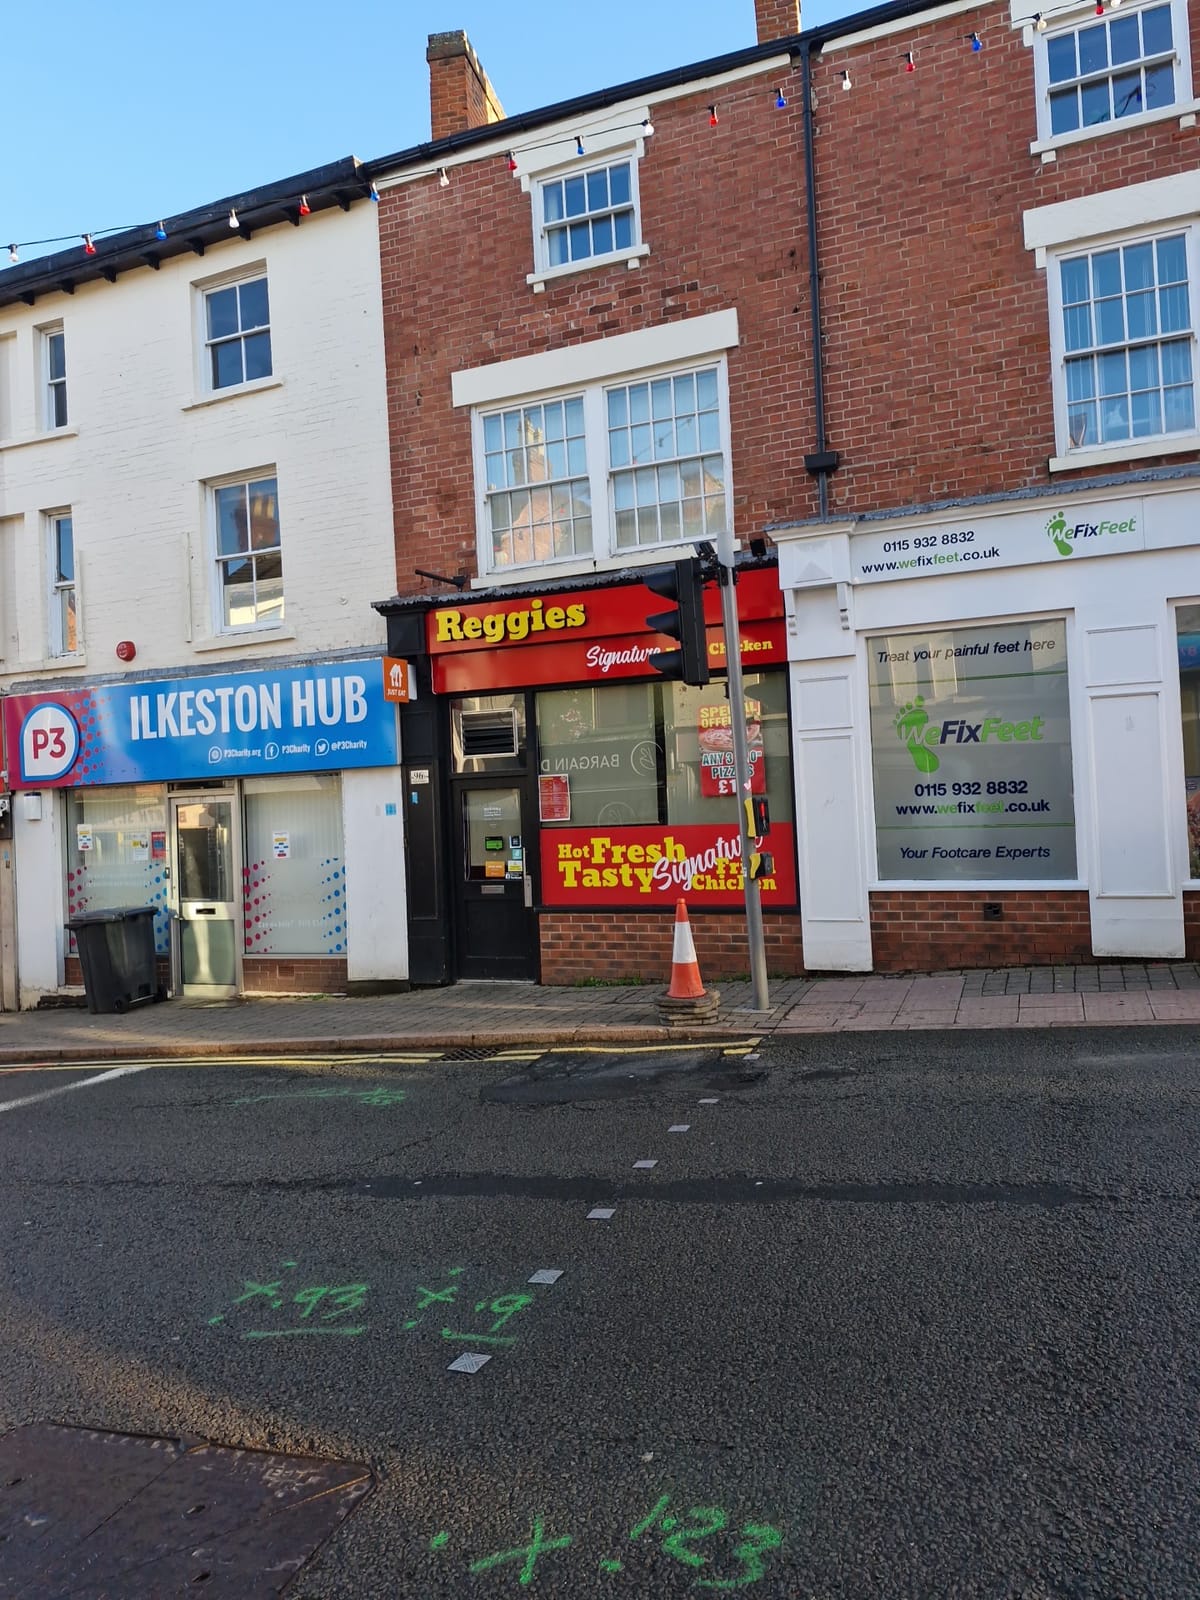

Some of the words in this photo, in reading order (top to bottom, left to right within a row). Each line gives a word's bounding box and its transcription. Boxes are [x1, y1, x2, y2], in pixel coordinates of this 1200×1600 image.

[883, 539, 910, 553] 0115
[913, 535, 937, 549] 932
[941, 530, 975, 545] 8832
[862, 546, 1000, 574] www.wefixfeet.co.uk
[435, 599, 586, 643] Reggies
[708, 640, 773, 655] Chken
[877, 651, 910, 663] Treat
[913, 649, 941, 662] your
[944, 643, 989, 660] painful
[993, 640, 1020, 653] feet
[1024, 639, 1056, 651] here
[129, 682, 282, 741] ILKESTON
[291, 675, 368, 728] HUB
[701, 716, 732, 728] OFFE
[32, 727, 66, 759] P3
[282, 744, 310, 755] P3Charity
[331, 740, 367, 751] @P3Charity
[702, 752, 724, 767] ANY
[725, 751, 734, 765] 3
[711, 764, 755, 779] PIZZS
[914, 783, 946, 797] 0115
[952, 782, 981, 795] 932
[986, 780, 1028, 794] 8832
[896, 799, 1050, 815] www.wefixfeet.co.uk
[557, 844, 590, 859] Hot
[590, 836, 687, 864] Fresh
[900, 847, 928, 859] Your
[932, 847, 991, 859] Footcare
[995, 846, 1050, 860] Experts
[652, 835, 764, 891] Signatu
[558, 860, 655, 893] Tasty
[692, 874, 777, 890] Chicn
